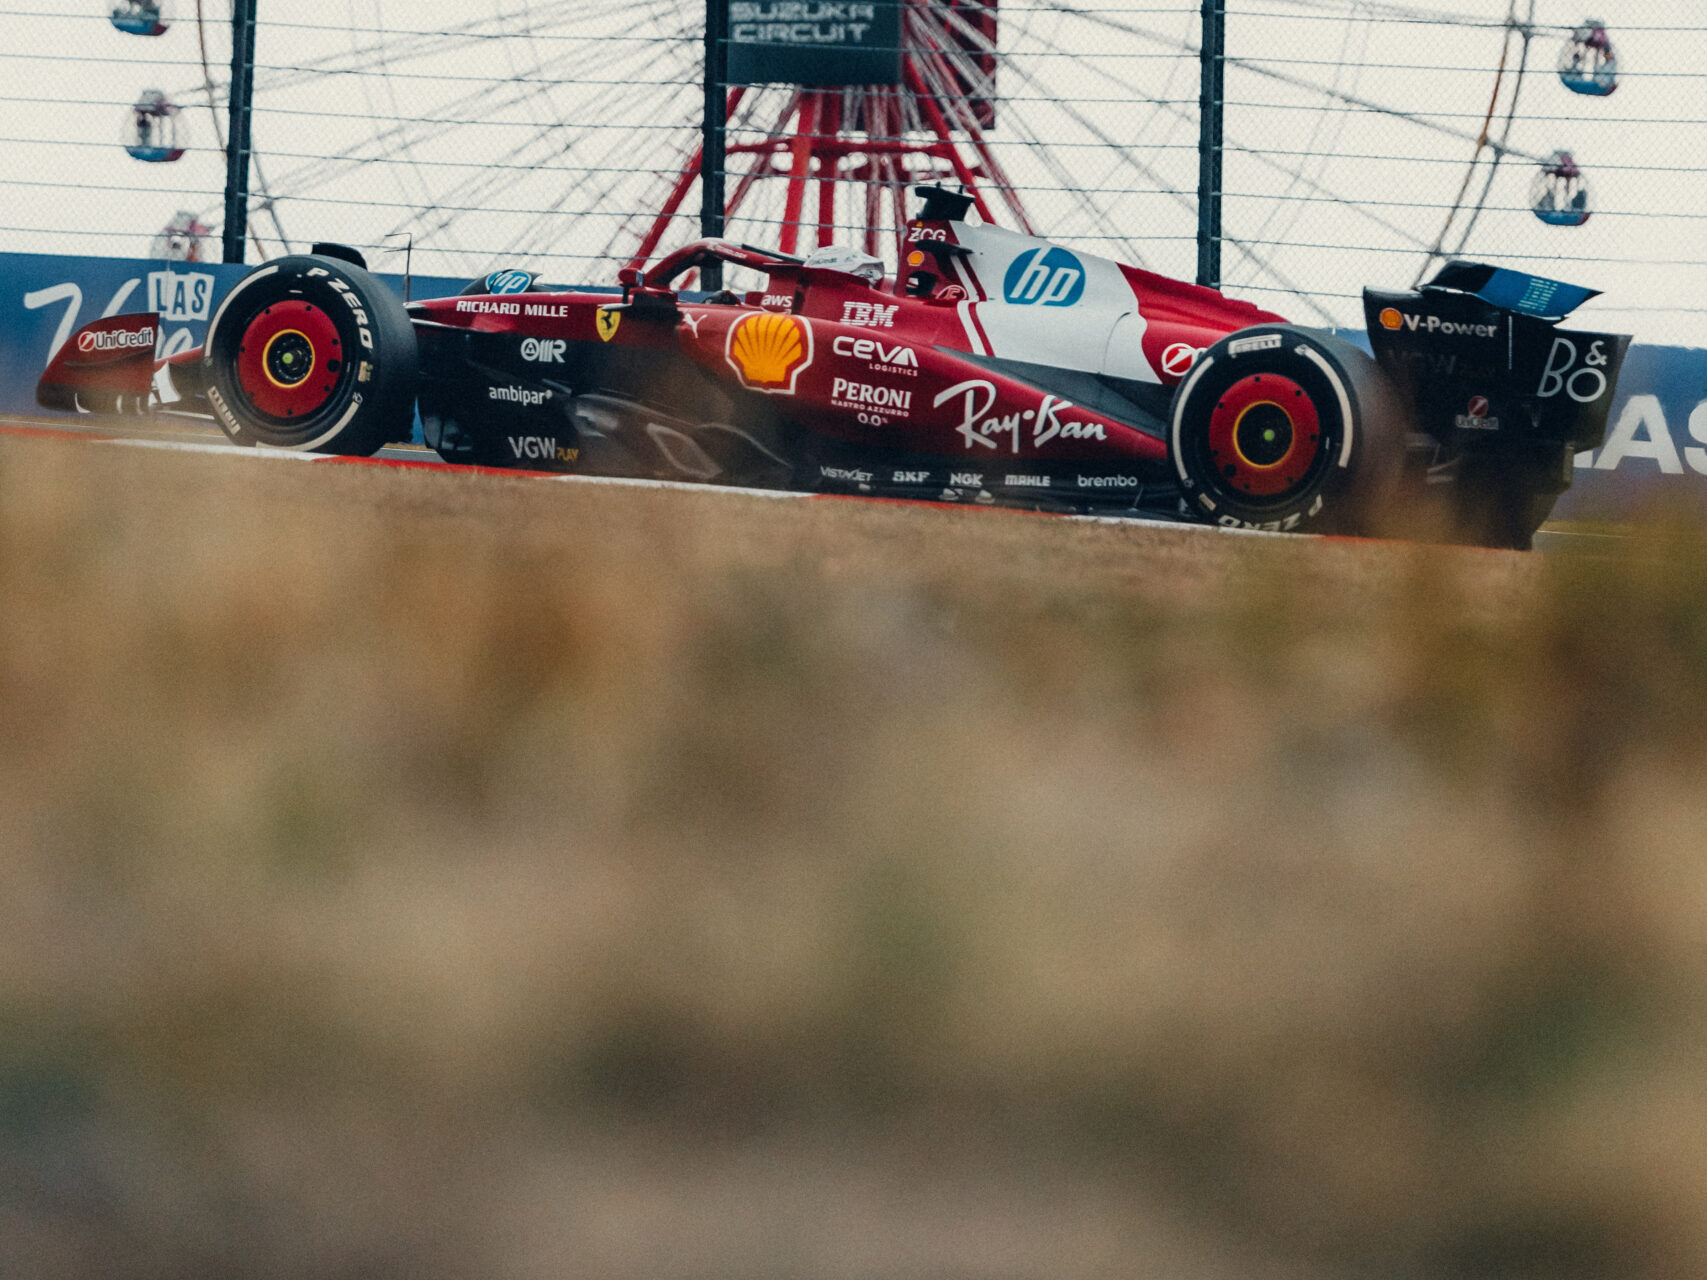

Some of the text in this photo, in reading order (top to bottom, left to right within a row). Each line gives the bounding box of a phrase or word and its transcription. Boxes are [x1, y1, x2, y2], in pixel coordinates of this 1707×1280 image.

[733, 22, 871, 43] CIRCUIT
[1009, 247, 1081, 307] hp
[155, 277, 207, 316] LAS
[761, 294, 793, 309] aws
[307, 267, 329, 277] P
[328, 278, 374, 350] ZERO
[456, 300, 568, 318] RICHARD MILLE
[840, 301, 899, 328] IBM
[1403, 313, 1499, 339] V-Power
[95, 328, 154, 349] UniCredit
[869, 363, 918, 377] LOGISTICS
[489, 385, 545, 407] ambipar
[832, 377, 912, 410] PERONI
[831, 399, 910, 418] NASTRO AZZURRO
[508, 436, 556, 460] VGW
[892, 471, 930, 483] SKF
[950, 472, 984, 487] NGK
[1004, 474, 1051, 487] MAHLE
[1077, 474, 1138, 488] brembo
